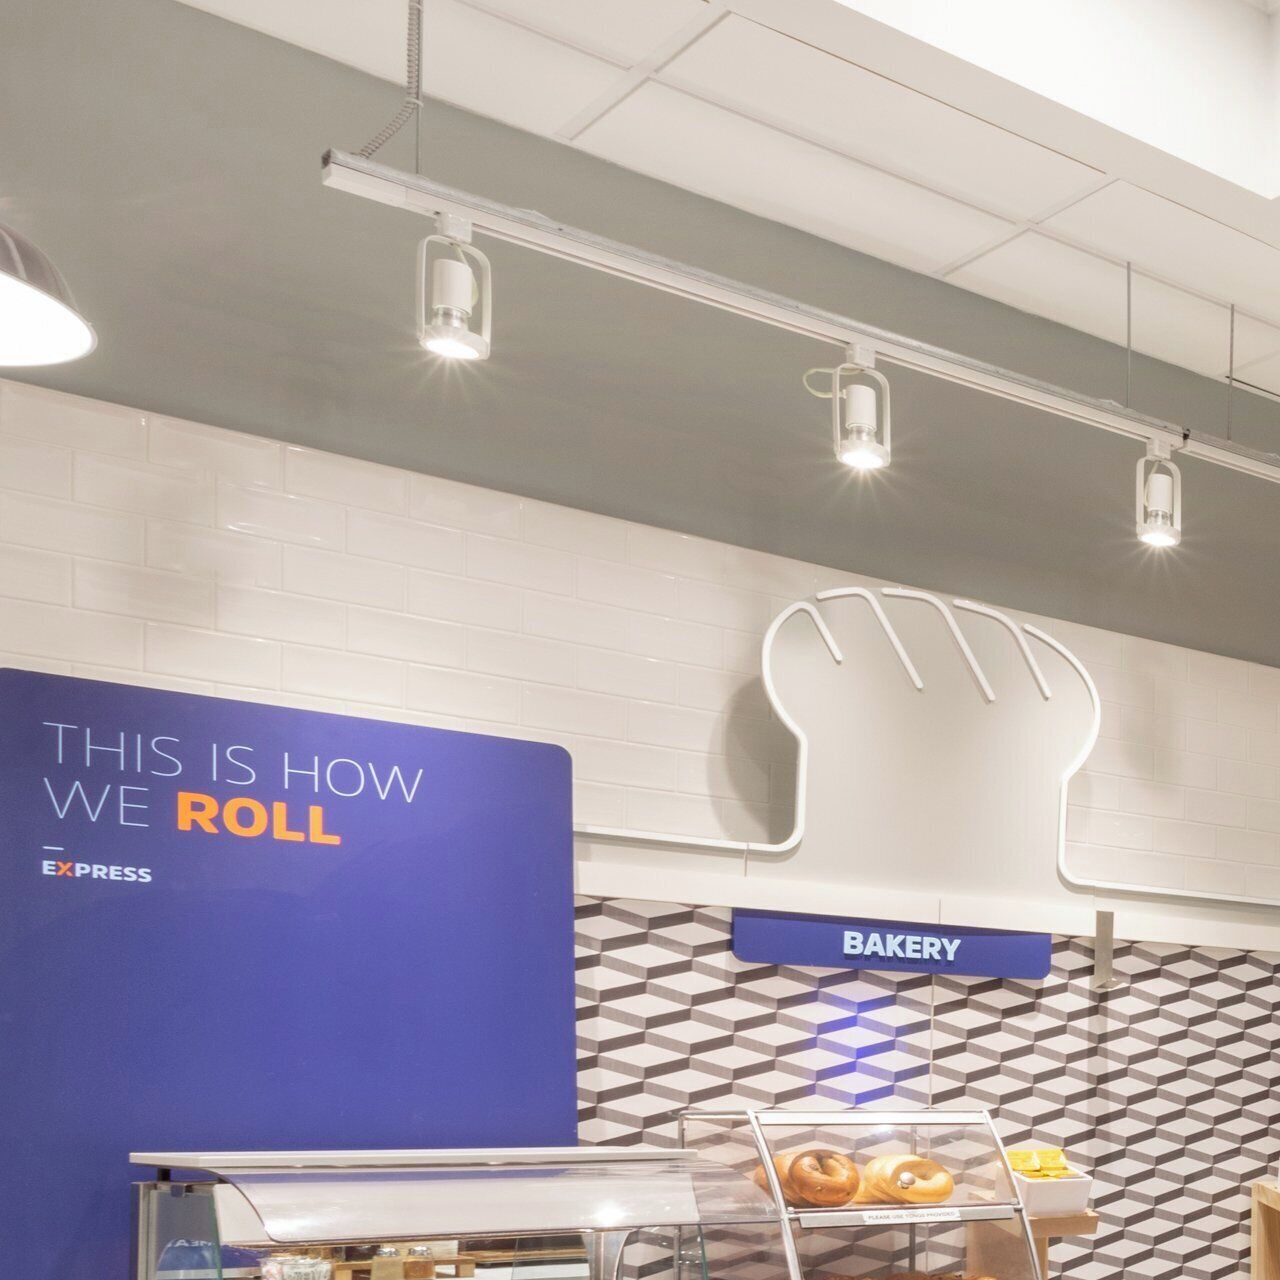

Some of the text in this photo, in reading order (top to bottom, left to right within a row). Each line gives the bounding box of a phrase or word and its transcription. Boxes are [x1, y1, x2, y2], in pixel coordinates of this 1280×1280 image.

[43, 722, 423, 802] THIS IS HOW
[43, 777, 341, 846] WE ROLL
[43, 860, 152, 882] EXPRESS
[843, 930, 962, 961] BAKERY
